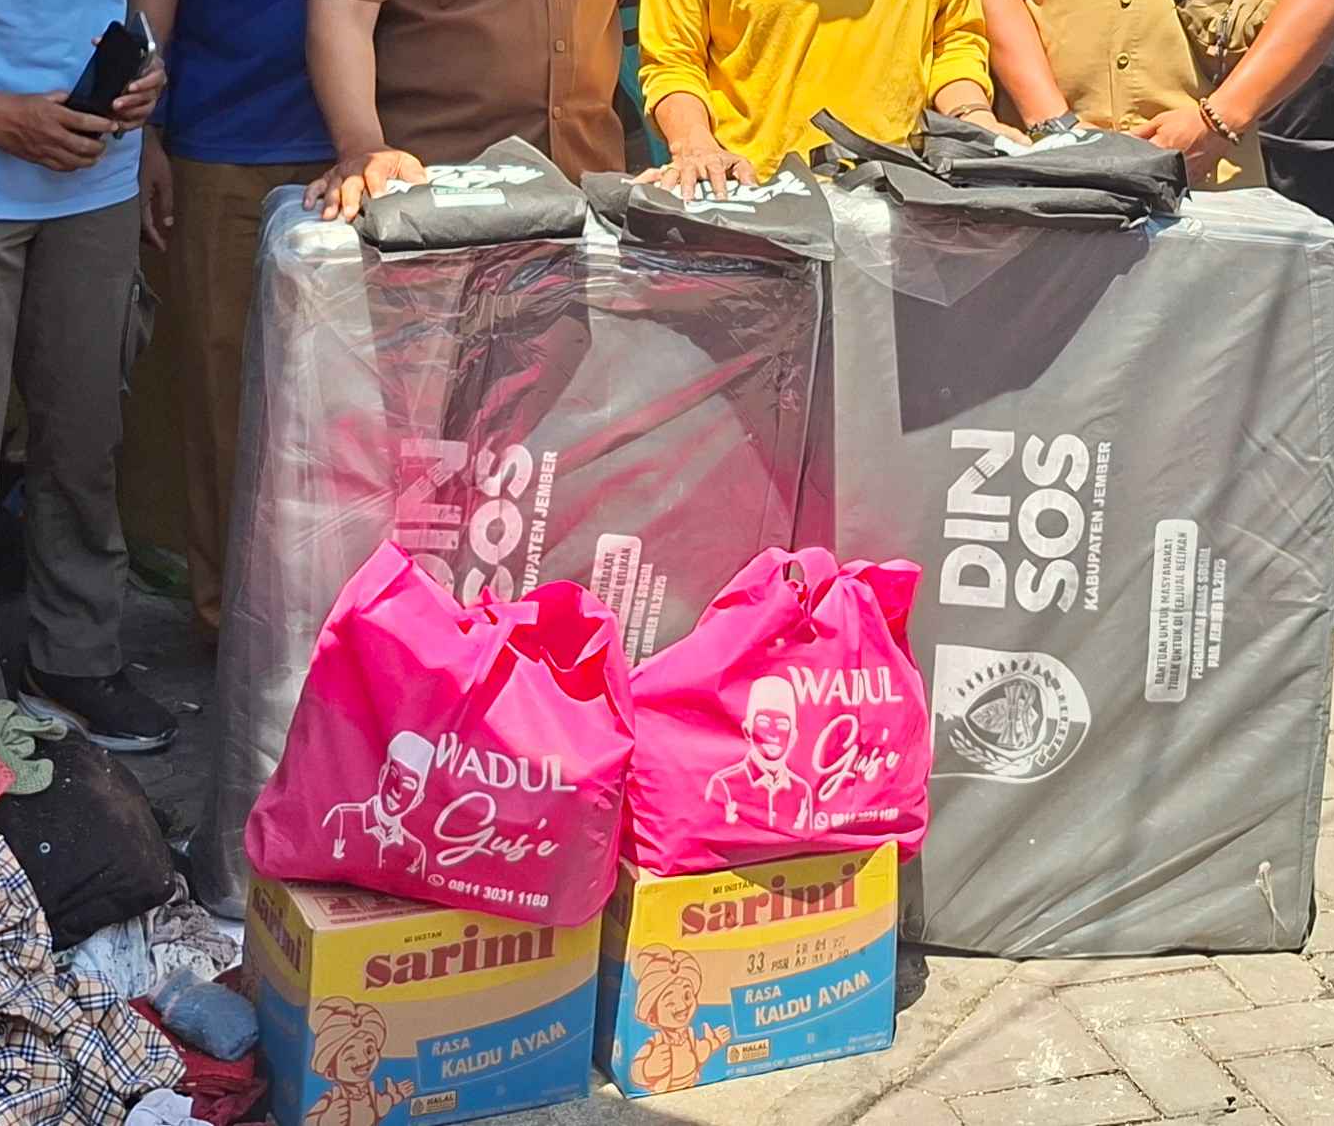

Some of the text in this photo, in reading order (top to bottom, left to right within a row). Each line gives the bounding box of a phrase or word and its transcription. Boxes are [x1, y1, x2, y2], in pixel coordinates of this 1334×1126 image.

[534, 450, 558, 517] JEMBER
[940, 429, 1015, 608] DIN
[1015, 433, 1090, 613] SOS
[1083, 441, 1112, 612] KABUPATEN JEMBER
[436, 732, 577, 793] WADUL
[448, 879, 549, 908] 0811 3031 1188
[681, 861, 858, 938] sarimi
[364, 924, 556, 991] sarimi
[745, 985, 782, 1005] RASA
[755, 970, 871, 1026] KALDU AYAM
[431, 1036, 471, 1057] RASA
[442, 1047, 503, 1079] KALDU
[510, 1021, 567, 1059] AYAM
